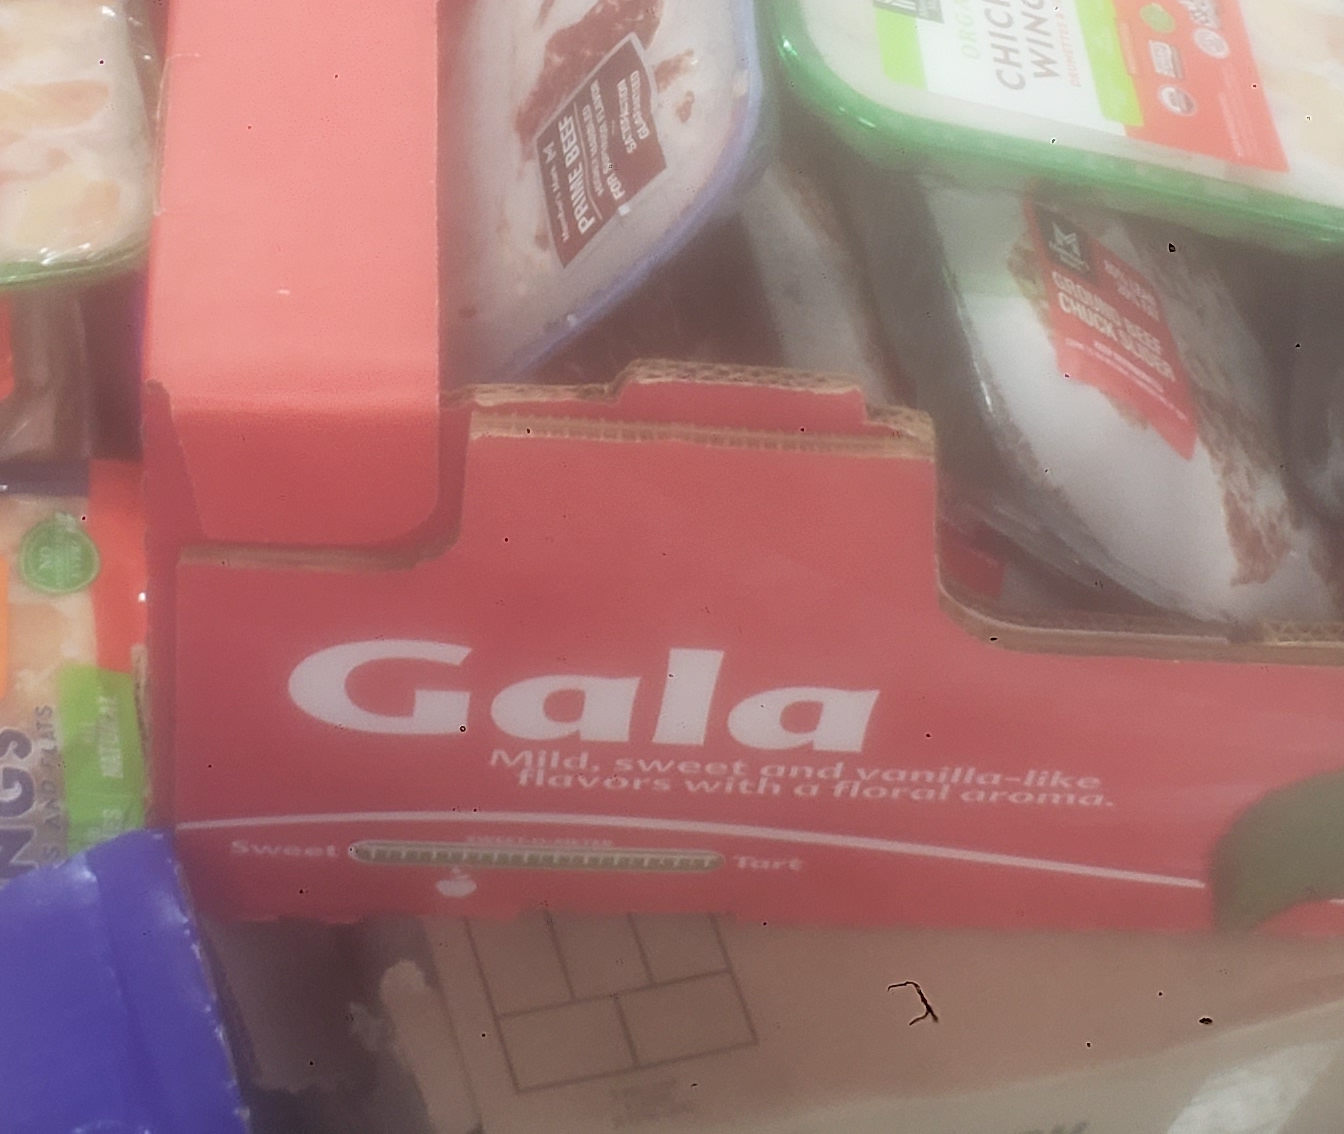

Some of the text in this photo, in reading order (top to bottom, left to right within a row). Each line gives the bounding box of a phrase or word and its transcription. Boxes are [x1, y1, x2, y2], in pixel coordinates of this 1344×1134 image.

[558, 115, 595, 235] PRIME BEEF
[606, 172, 626, 201] FOR
[287, 639, 881, 753] Gala
[489, 749, 1102, 790] Mild, sweet and vanilla-like
[517, 767, 1114, 807] flavors with a floral aroma.
[229, 839, 338, 858] Sweet
[731, 854, 804, 873] Tart
